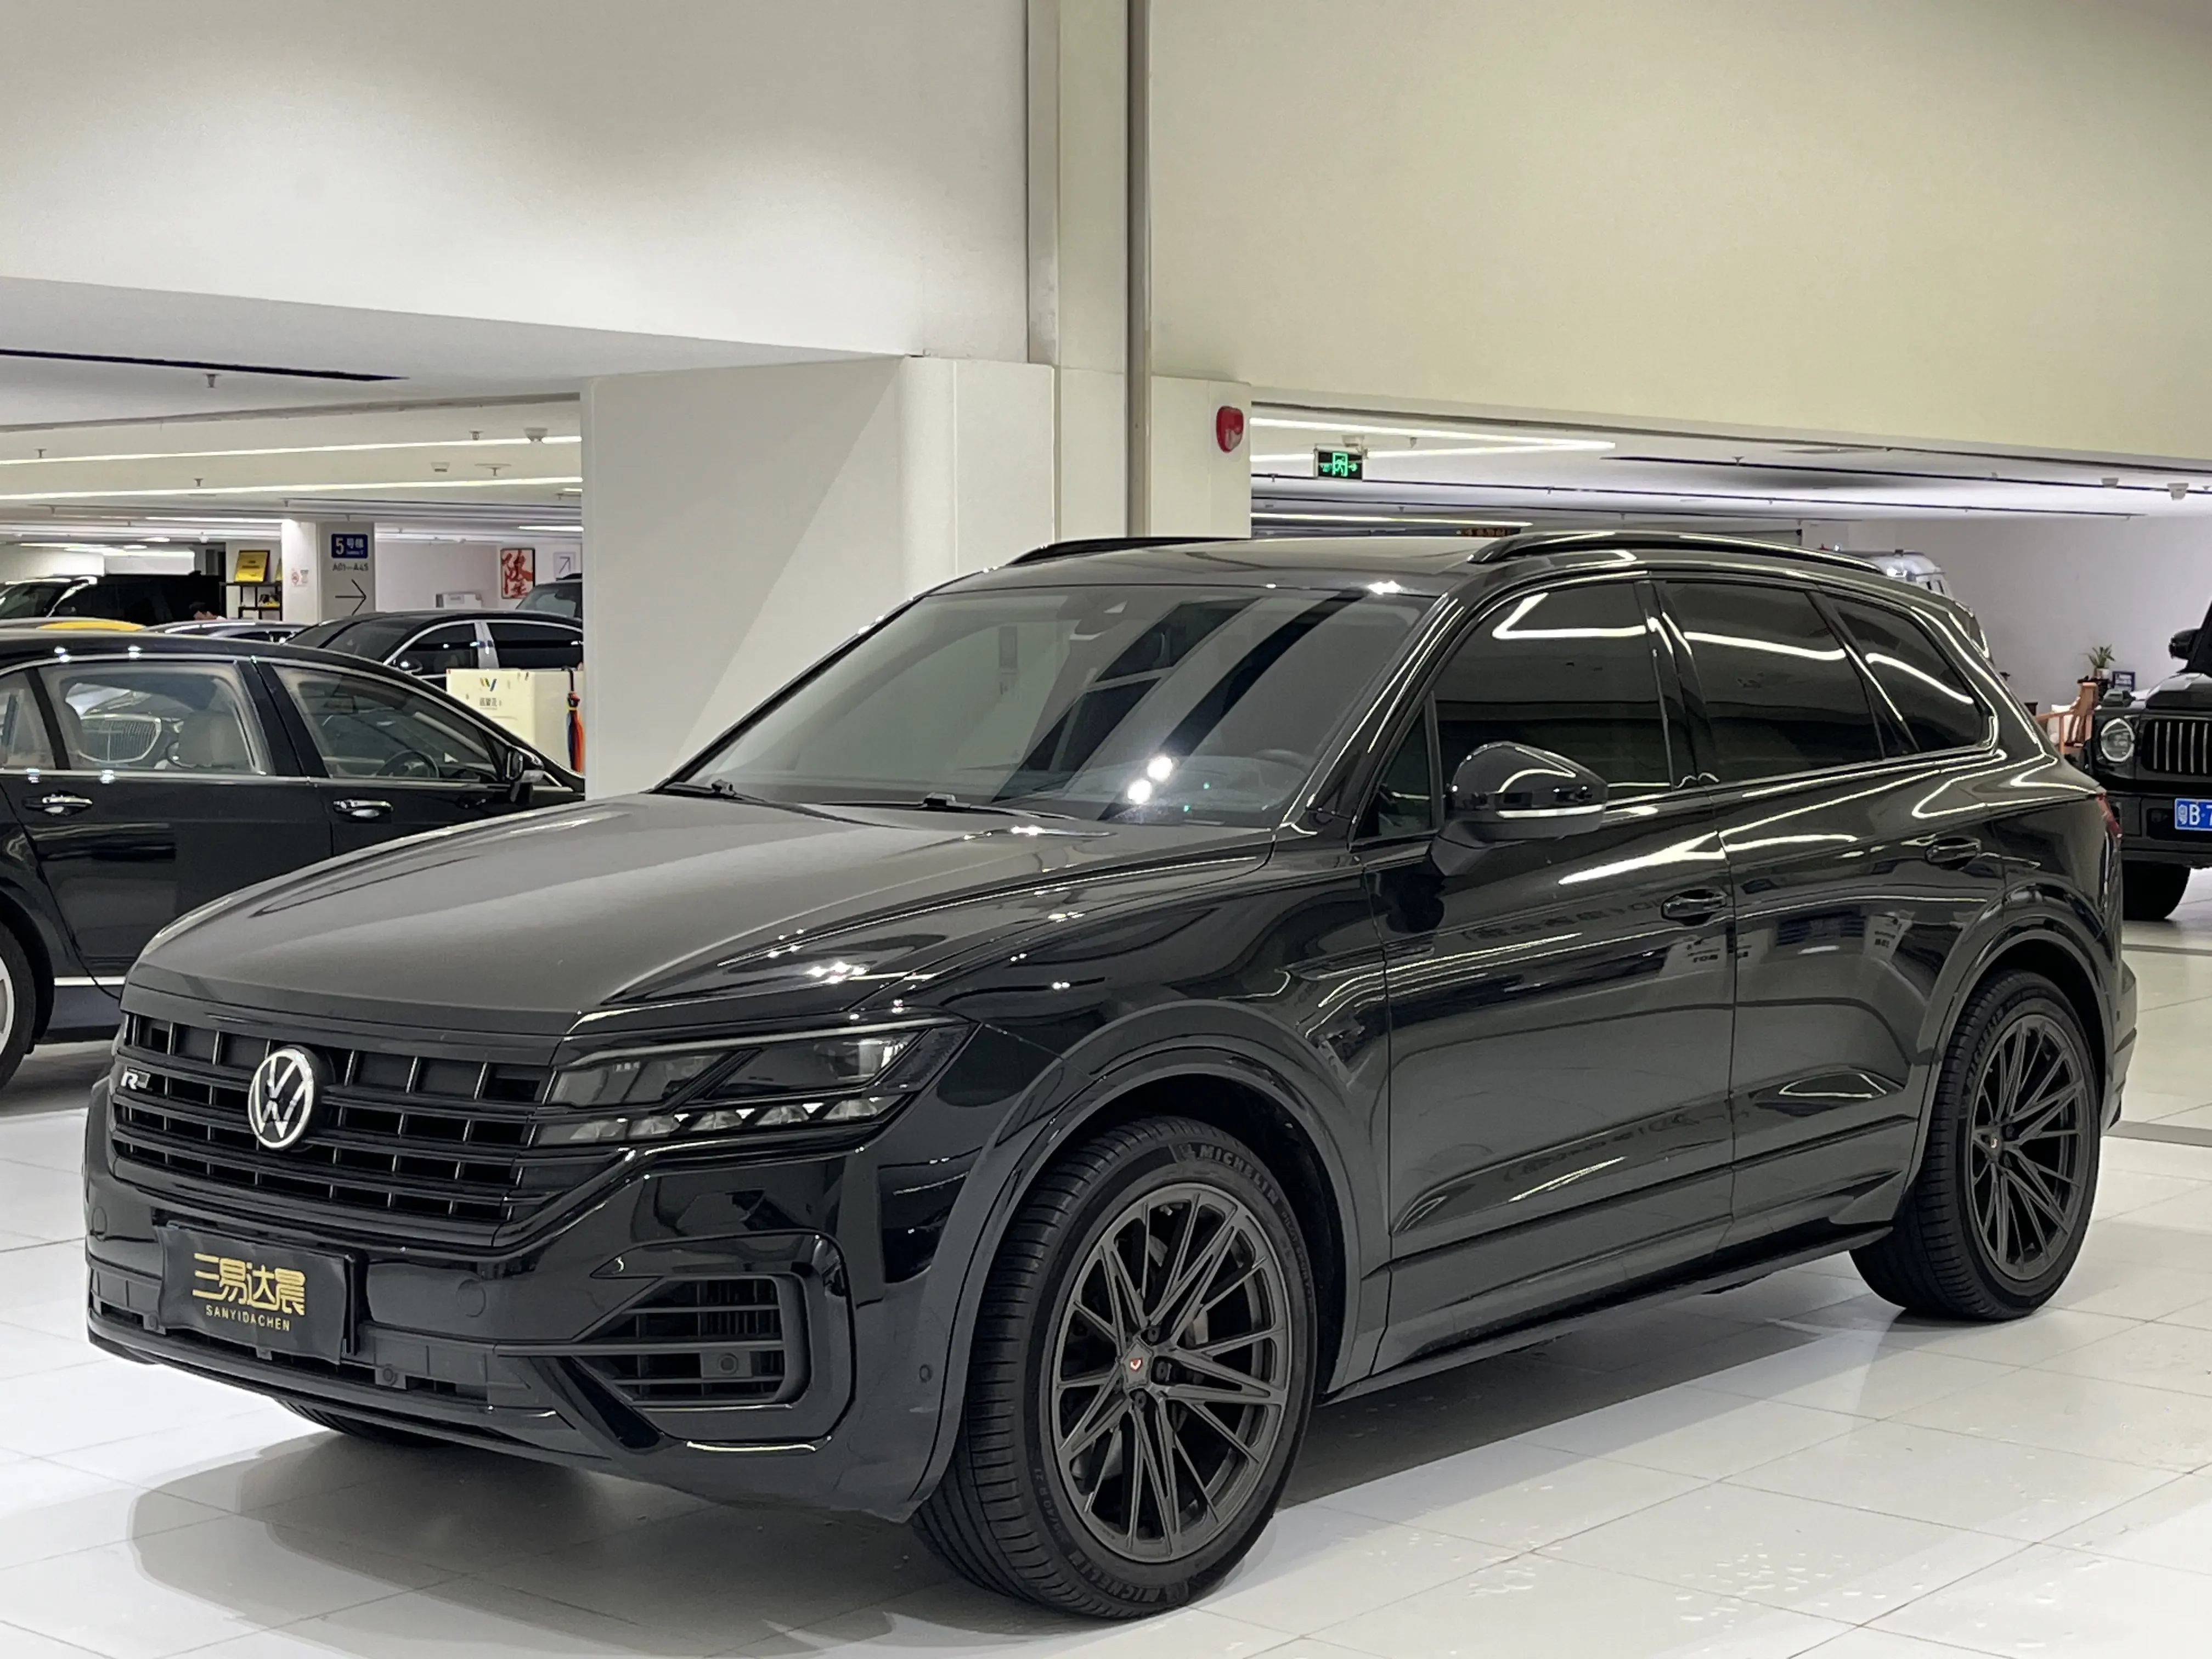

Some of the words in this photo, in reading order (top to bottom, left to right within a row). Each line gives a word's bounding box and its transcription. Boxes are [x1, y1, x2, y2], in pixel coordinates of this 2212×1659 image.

[1200, 1144, 1280, 1205] MICHELIN
[192, 1252, 306, 1316] 三易达晨
[205, 1304, 291, 1331] SANYIDACHEN
